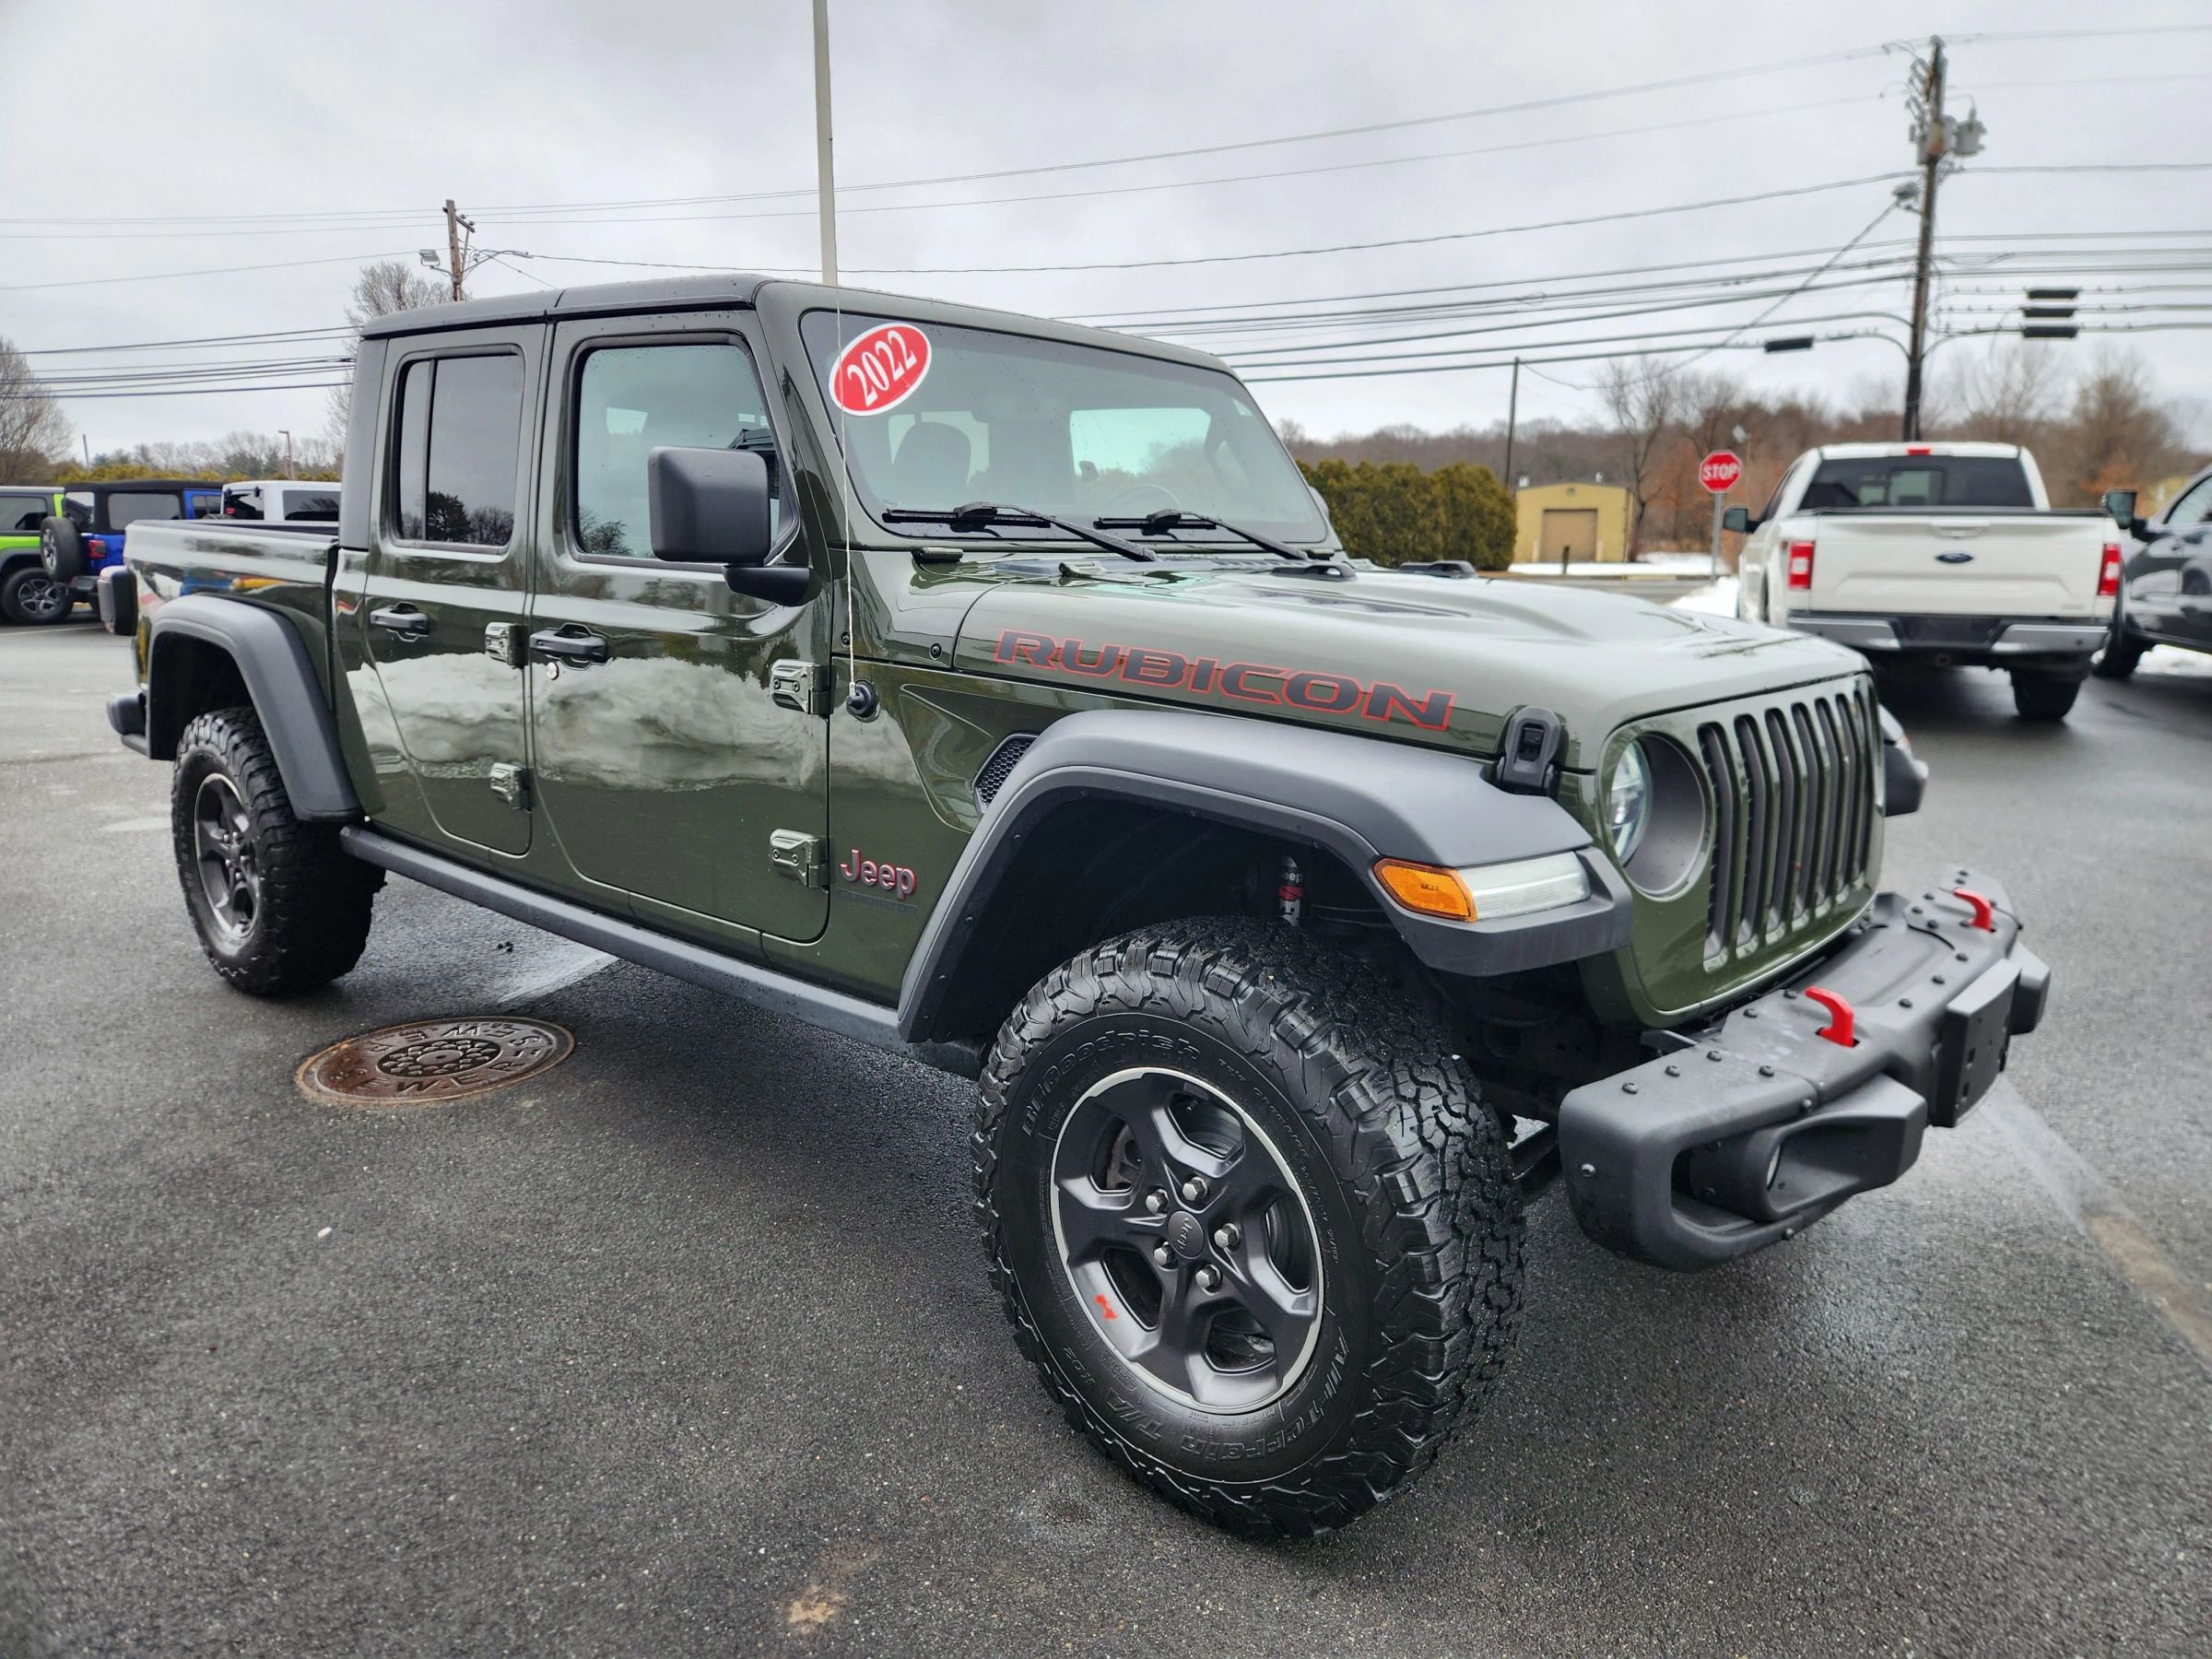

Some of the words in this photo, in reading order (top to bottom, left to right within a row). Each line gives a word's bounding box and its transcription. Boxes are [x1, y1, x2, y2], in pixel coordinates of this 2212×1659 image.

[847, 330, 917, 407] 2022
[1702, 463, 1738, 481] STOP
[994, 628, 1456, 731] RUBICON
[841, 849, 917, 900] Jeep
